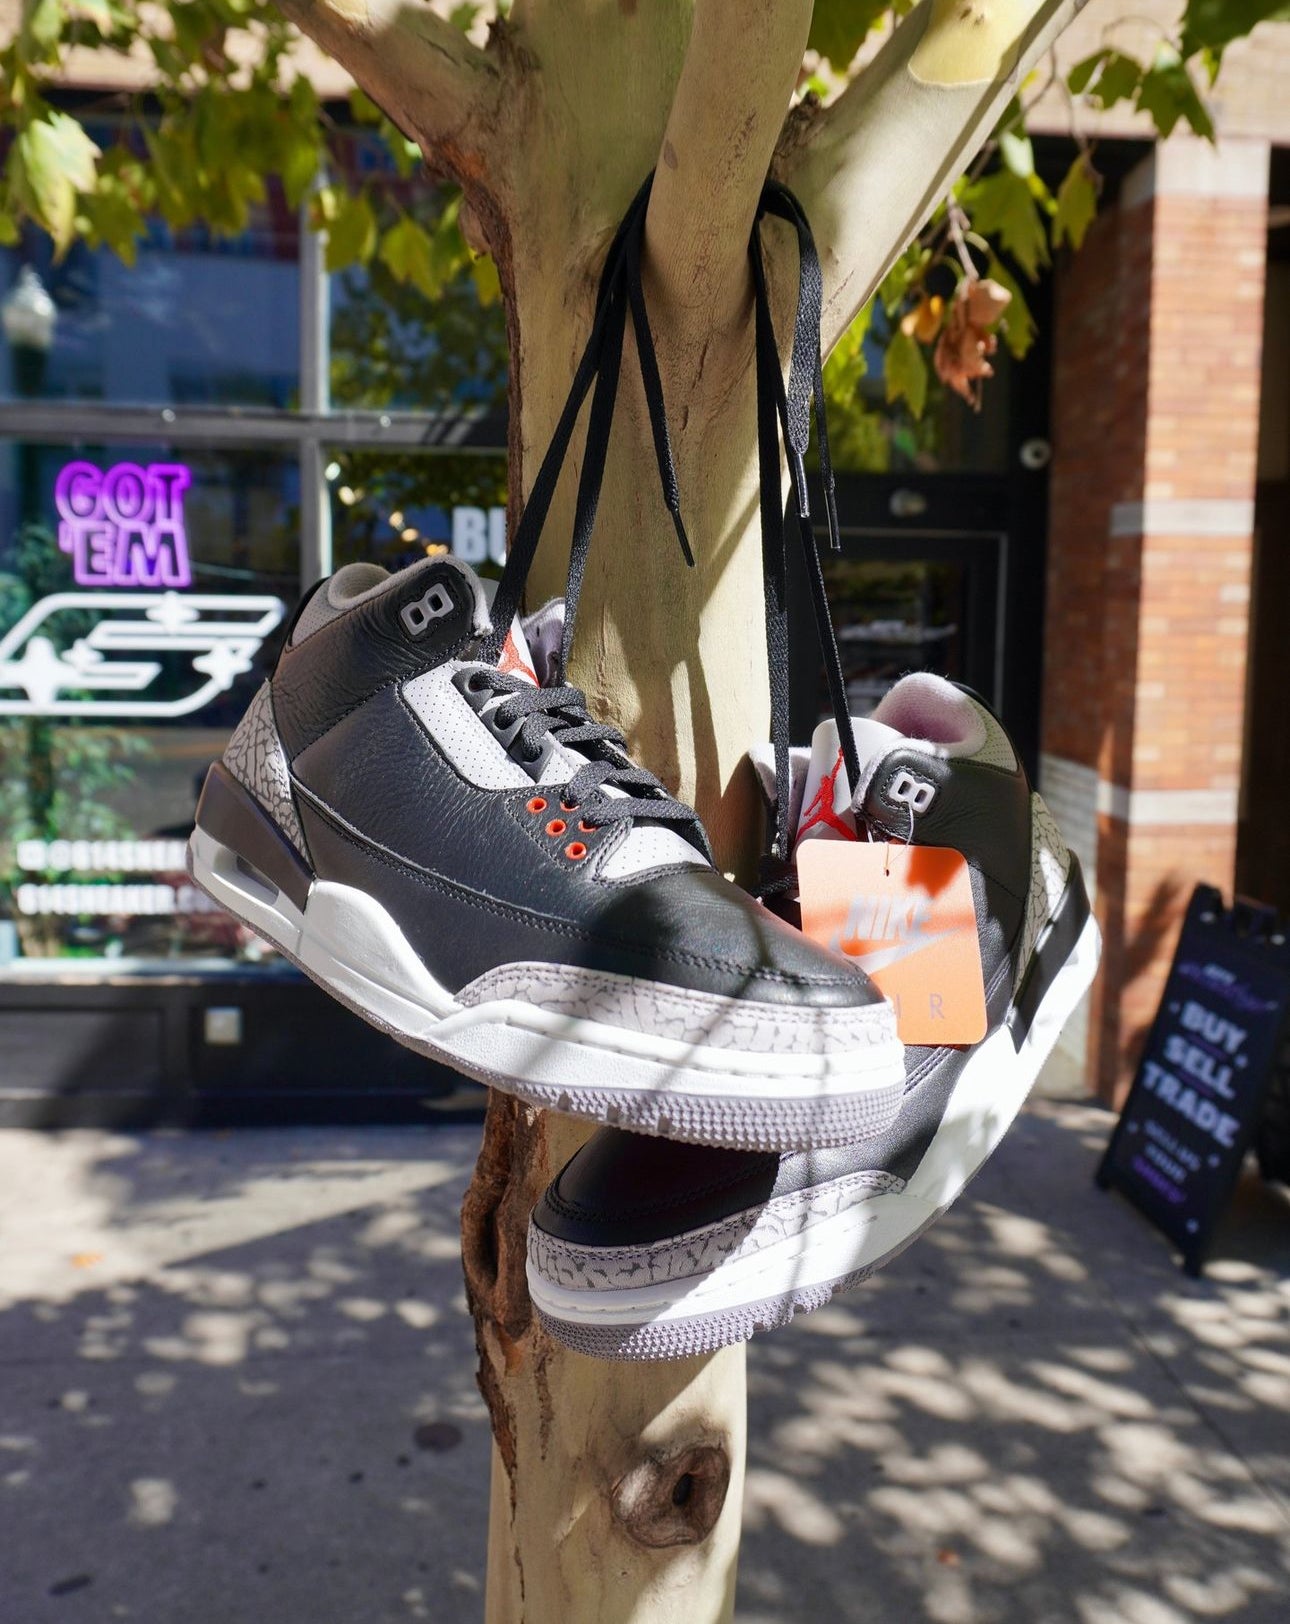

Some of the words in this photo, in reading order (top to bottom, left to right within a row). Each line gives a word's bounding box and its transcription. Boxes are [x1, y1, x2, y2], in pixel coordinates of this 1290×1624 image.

[54, 461, 191, 525] GOT
[845, 896, 932, 941] NIKE
[895, 992, 945, 1020] IR
[1180, 1001, 1247, 1053] BUY
[1162, 1034, 1236, 1099] SELL
[1142, 1060, 1241, 1148] TRADE
